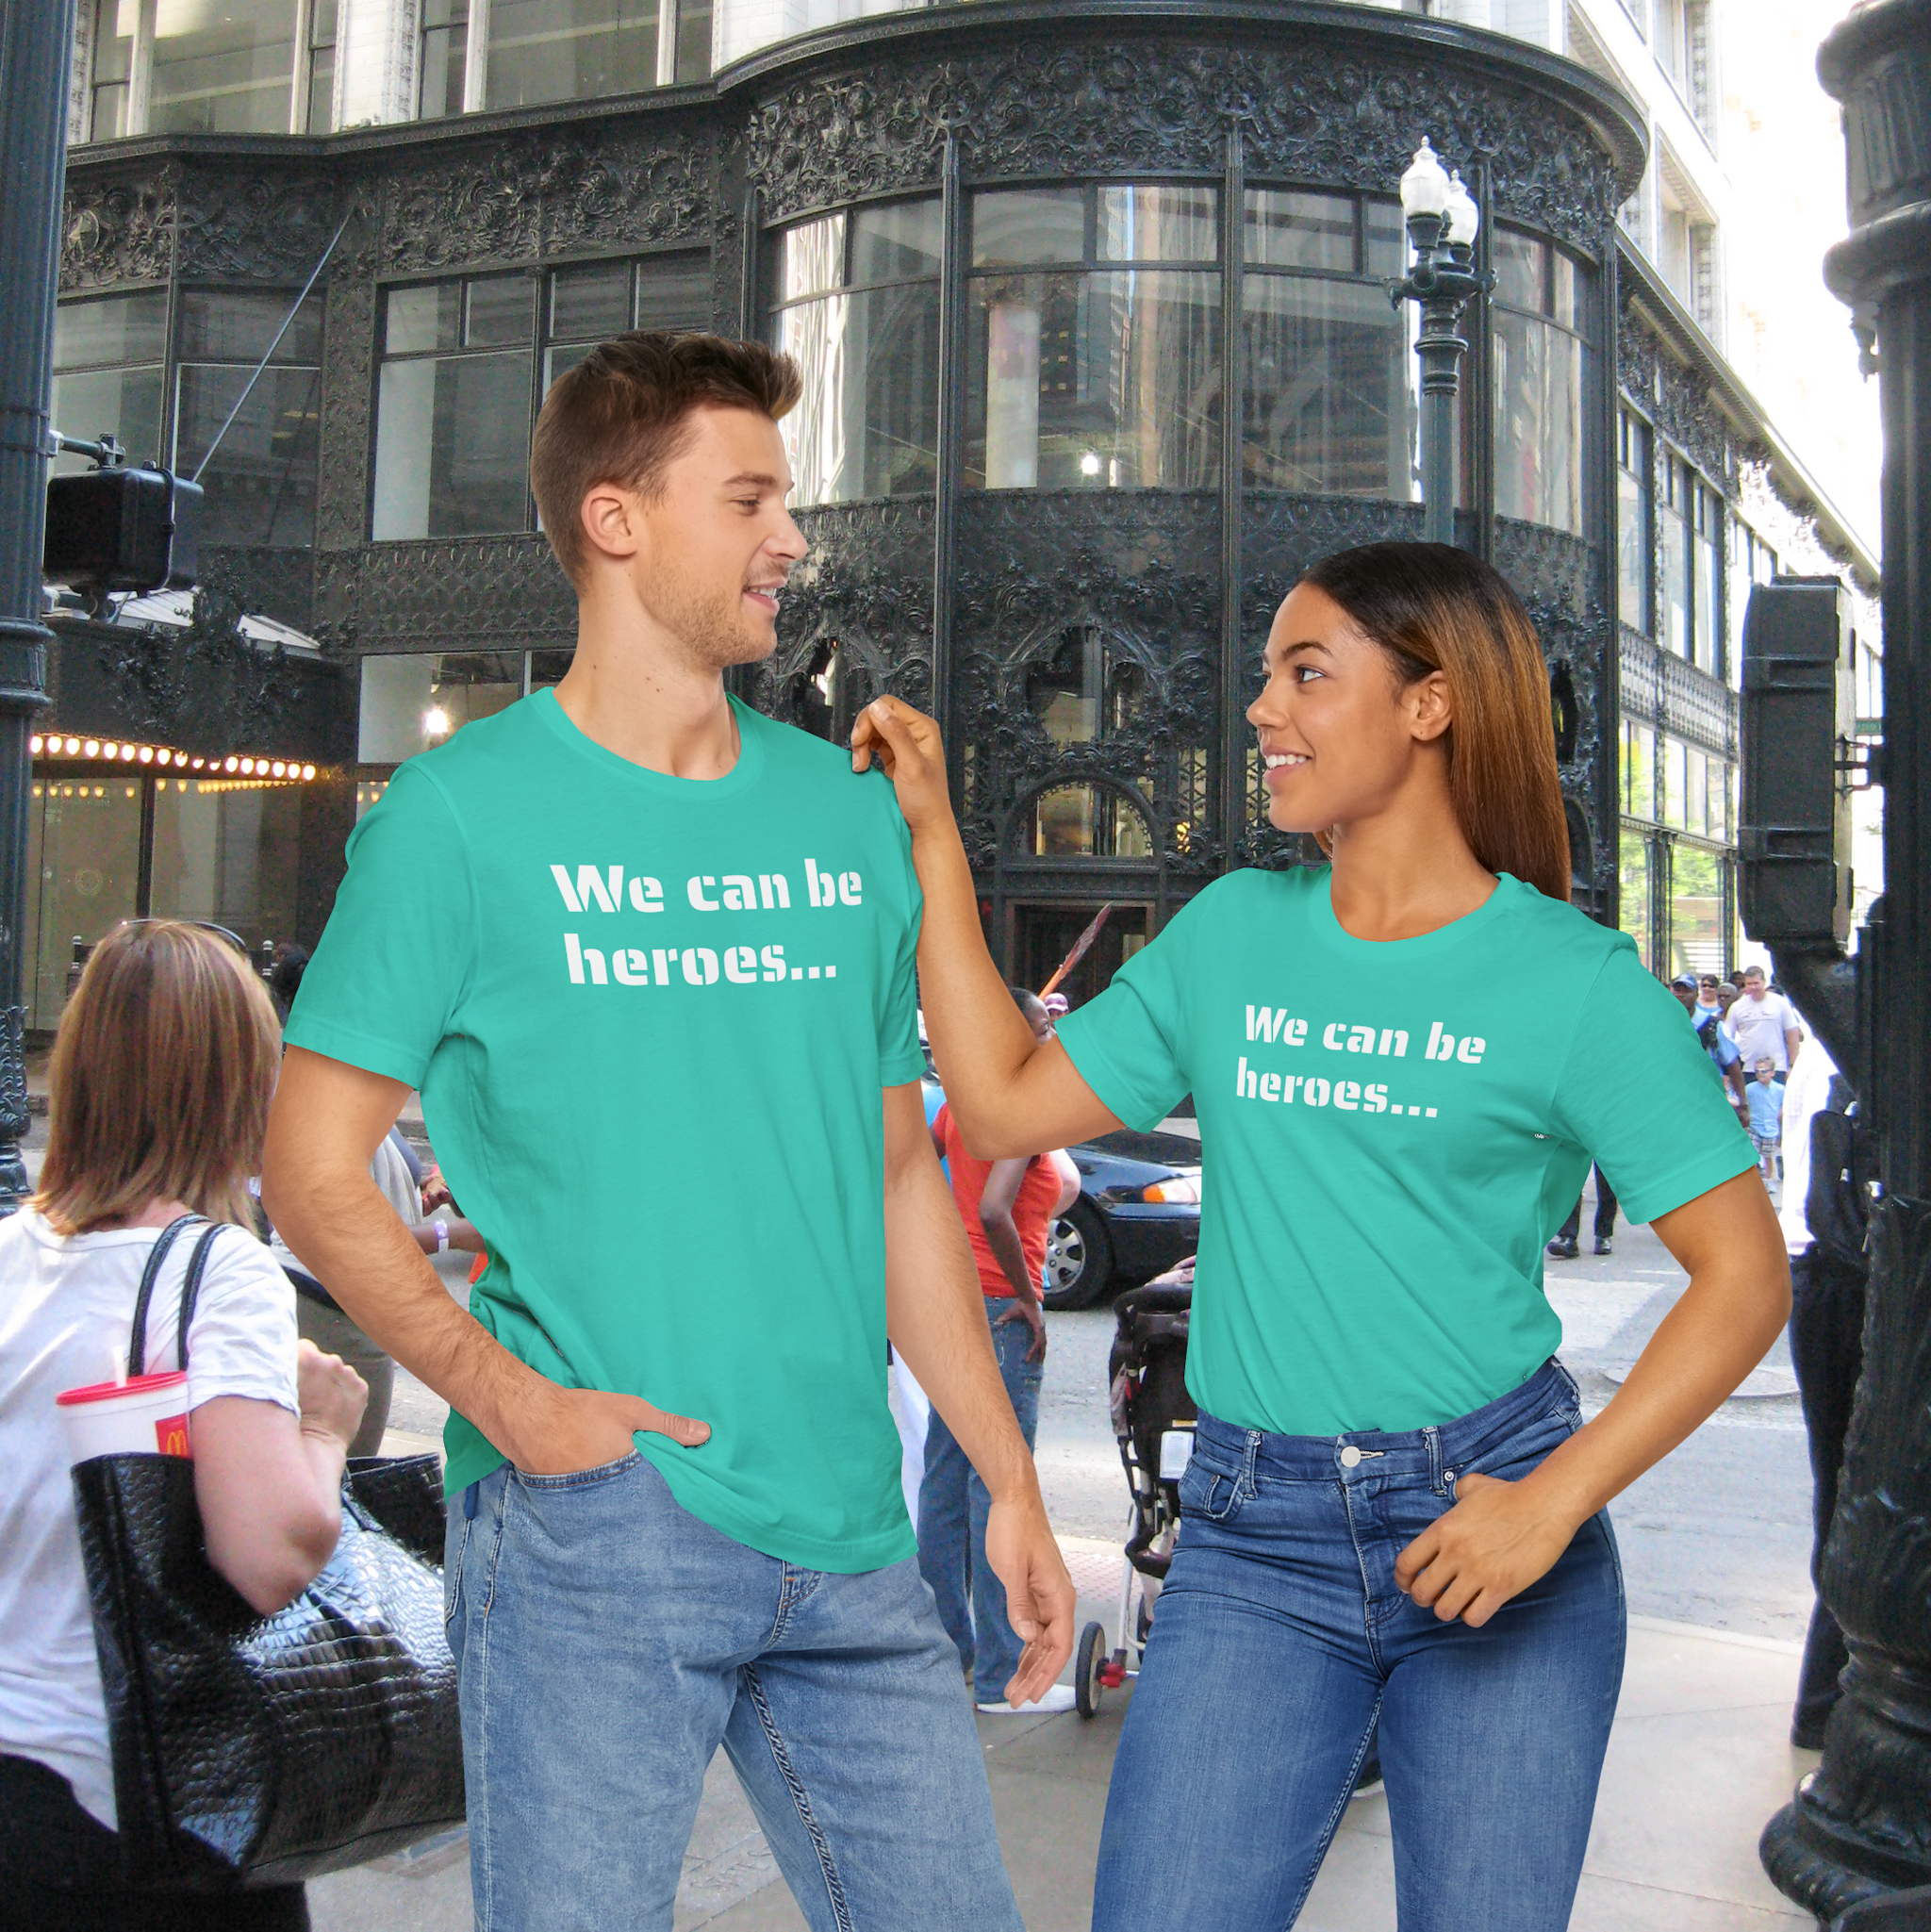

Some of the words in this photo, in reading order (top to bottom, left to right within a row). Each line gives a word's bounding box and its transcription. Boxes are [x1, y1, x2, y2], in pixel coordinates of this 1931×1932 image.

[549, 864, 665, 913] We
[686, 873, 791, 912] can
[803, 857, 863, 908] be
[563, 933, 837, 986] heroes...
[1246, 1004, 1309, 1047] We
[1322, 1022, 1410, 1058] can
[1424, 1021, 1487, 1065] be
[1236, 1056, 1438, 1118] heroes...
